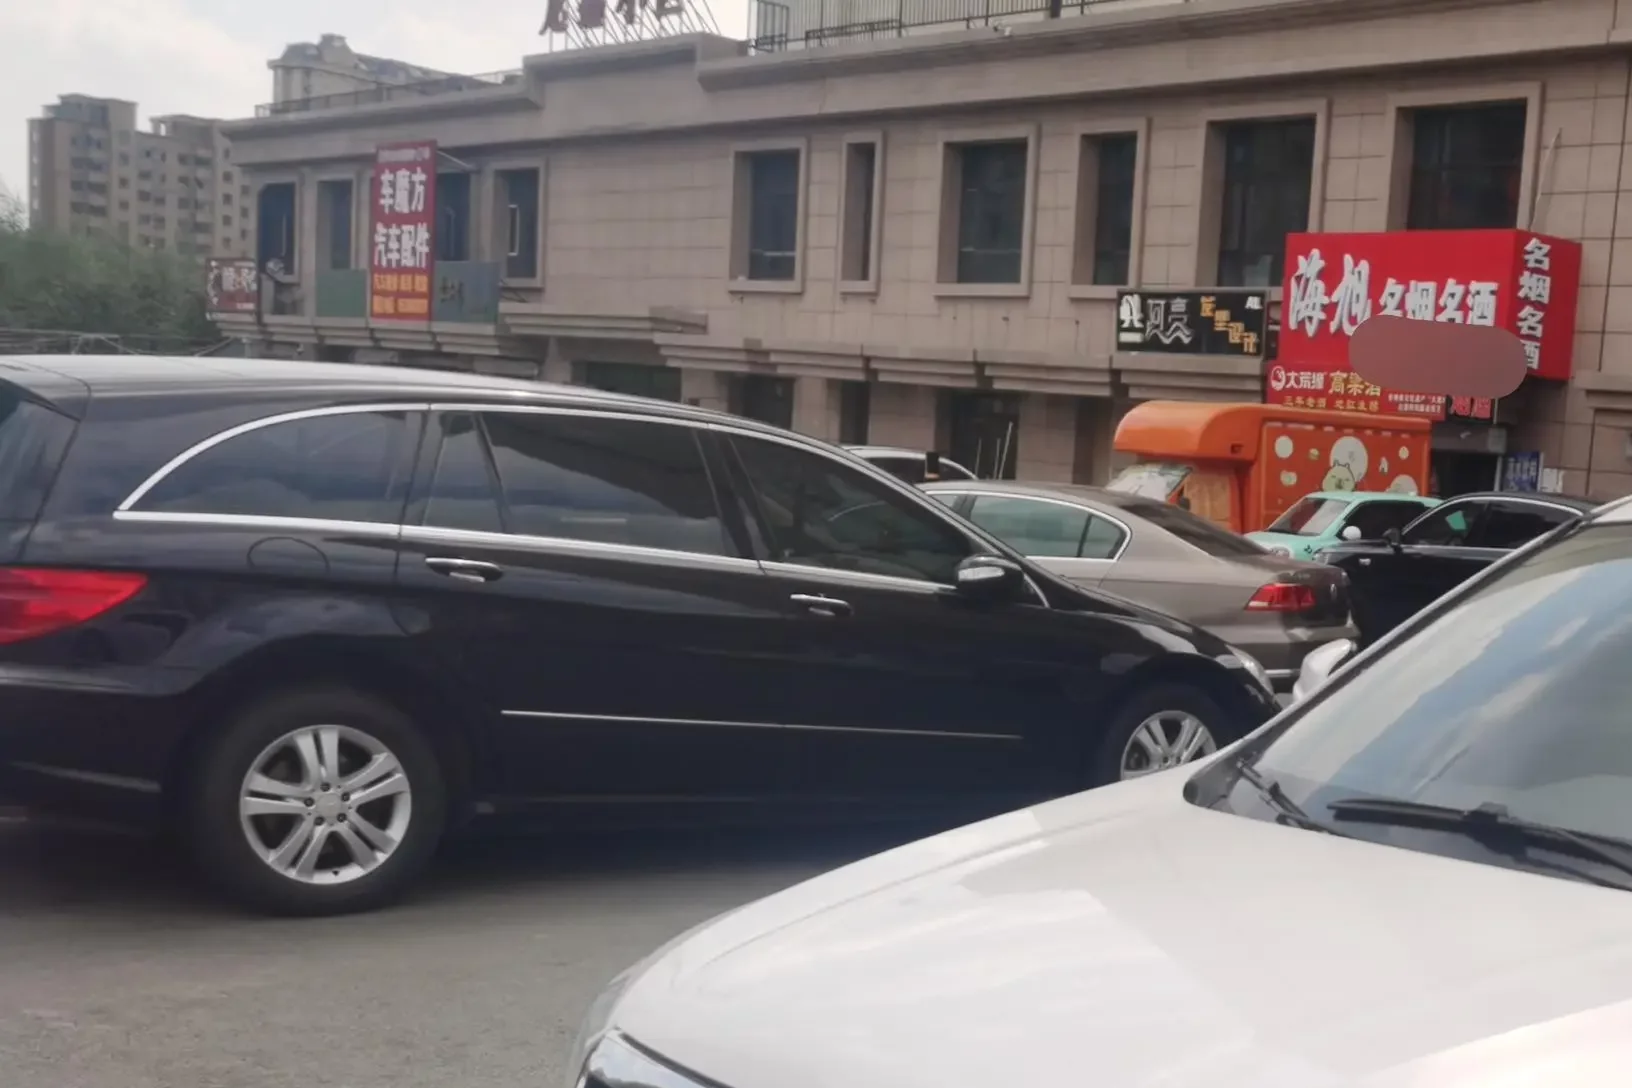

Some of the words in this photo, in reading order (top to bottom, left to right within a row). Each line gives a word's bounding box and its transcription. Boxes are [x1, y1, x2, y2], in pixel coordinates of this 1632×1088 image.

[373, 222, 431, 269] 汽车配件
[1516, 238, 1552, 370] 名烟名酒
